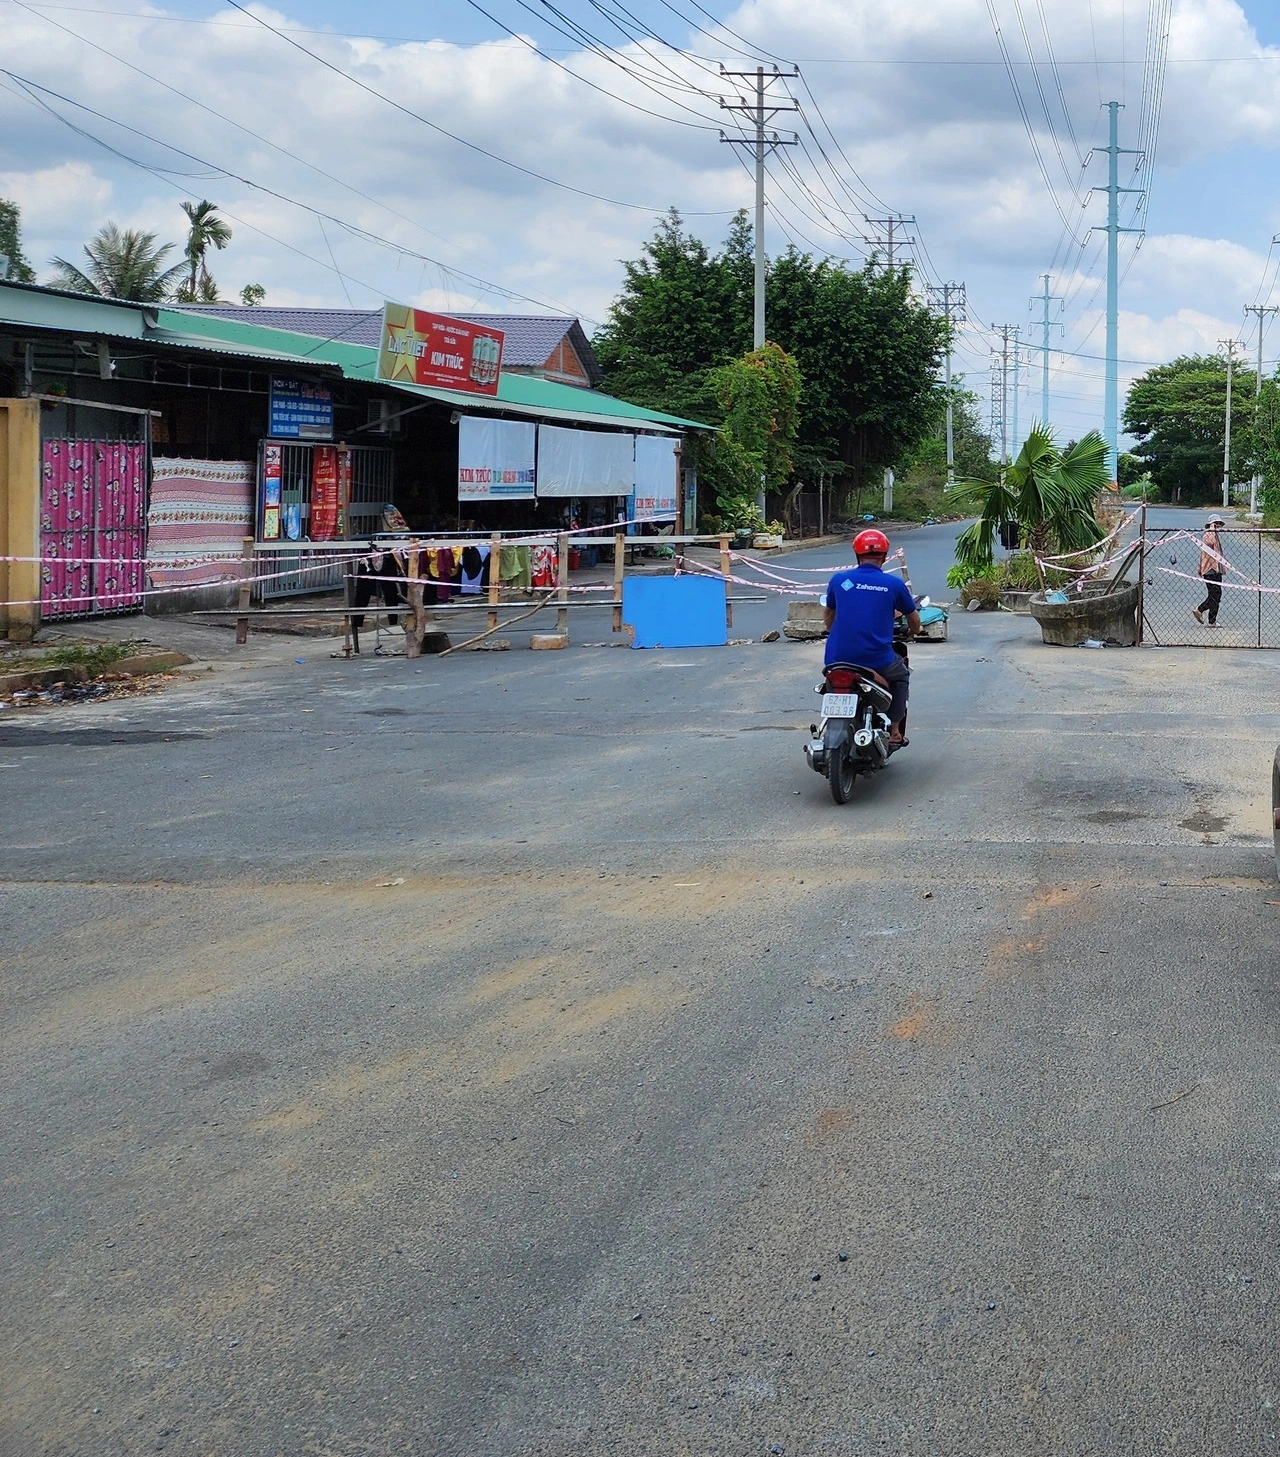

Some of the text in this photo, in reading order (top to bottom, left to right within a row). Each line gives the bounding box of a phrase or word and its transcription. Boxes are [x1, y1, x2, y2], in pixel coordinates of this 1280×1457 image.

[431, 351, 445, 367] KIM
[446, 352, 464, 370] TRÚC
[856, 583, 889, 592] Zahonero
